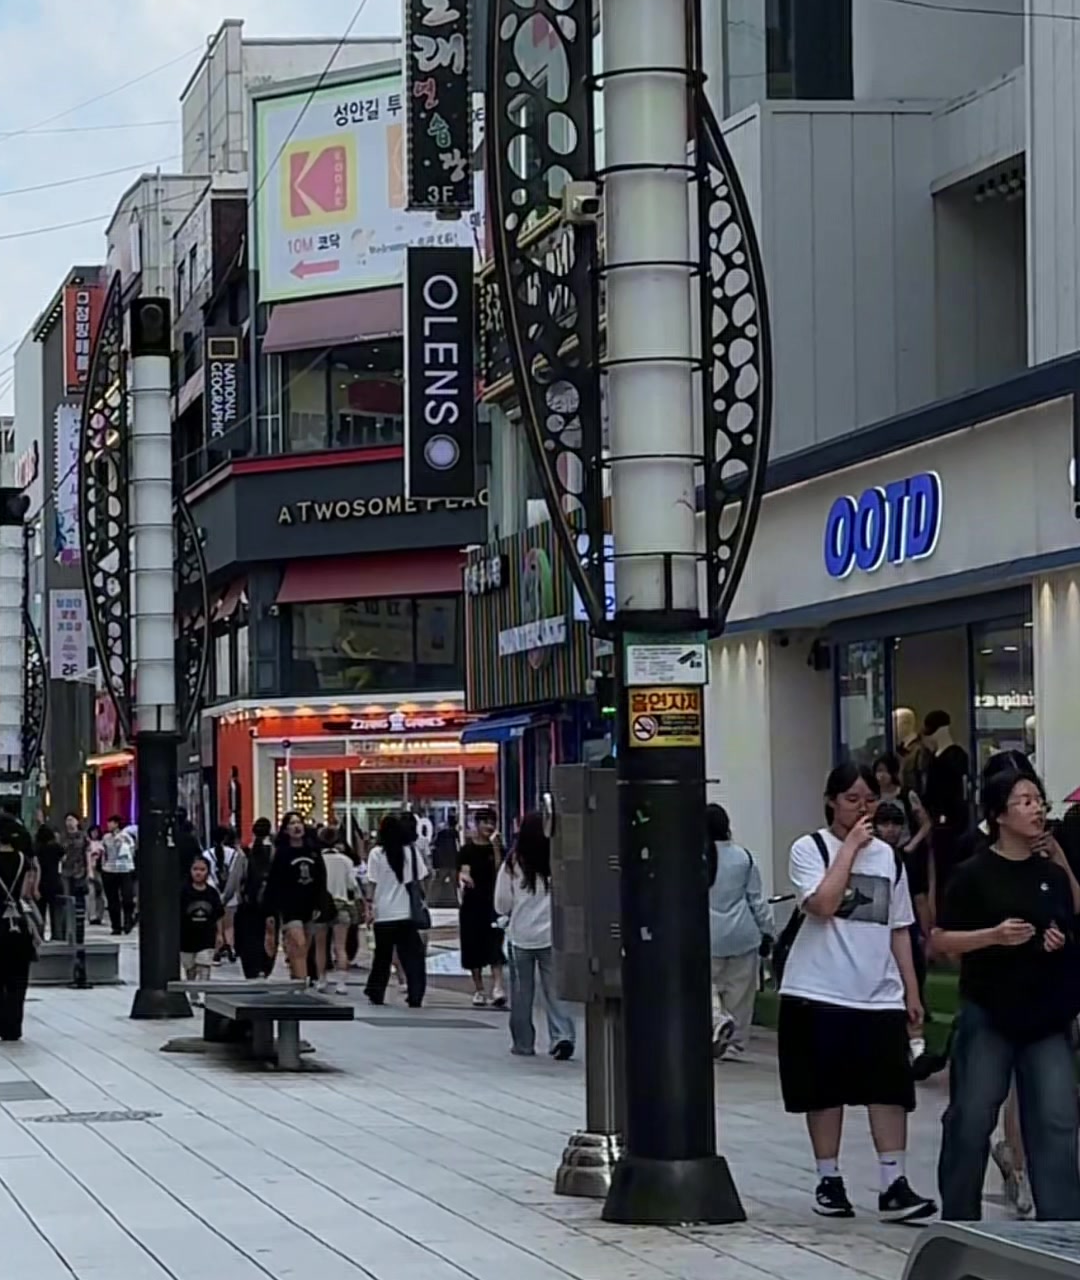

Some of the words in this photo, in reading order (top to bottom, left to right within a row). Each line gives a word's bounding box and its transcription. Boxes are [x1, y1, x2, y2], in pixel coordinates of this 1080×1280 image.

[333, 98, 380, 127] 성안길
[427, 185, 455, 203] 3F
[422, 274, 460, 426] OLENS
[210, 361, 224, 438] GEOGRAPHIC
[224, 362, 237, 423] NATIONAL
[278, 506, 292, 524] A
[297, 495, 418, 521] TWOSOME
[824, 470, 943, 579] OOTD
[62, 663, 78, 676] 2F
